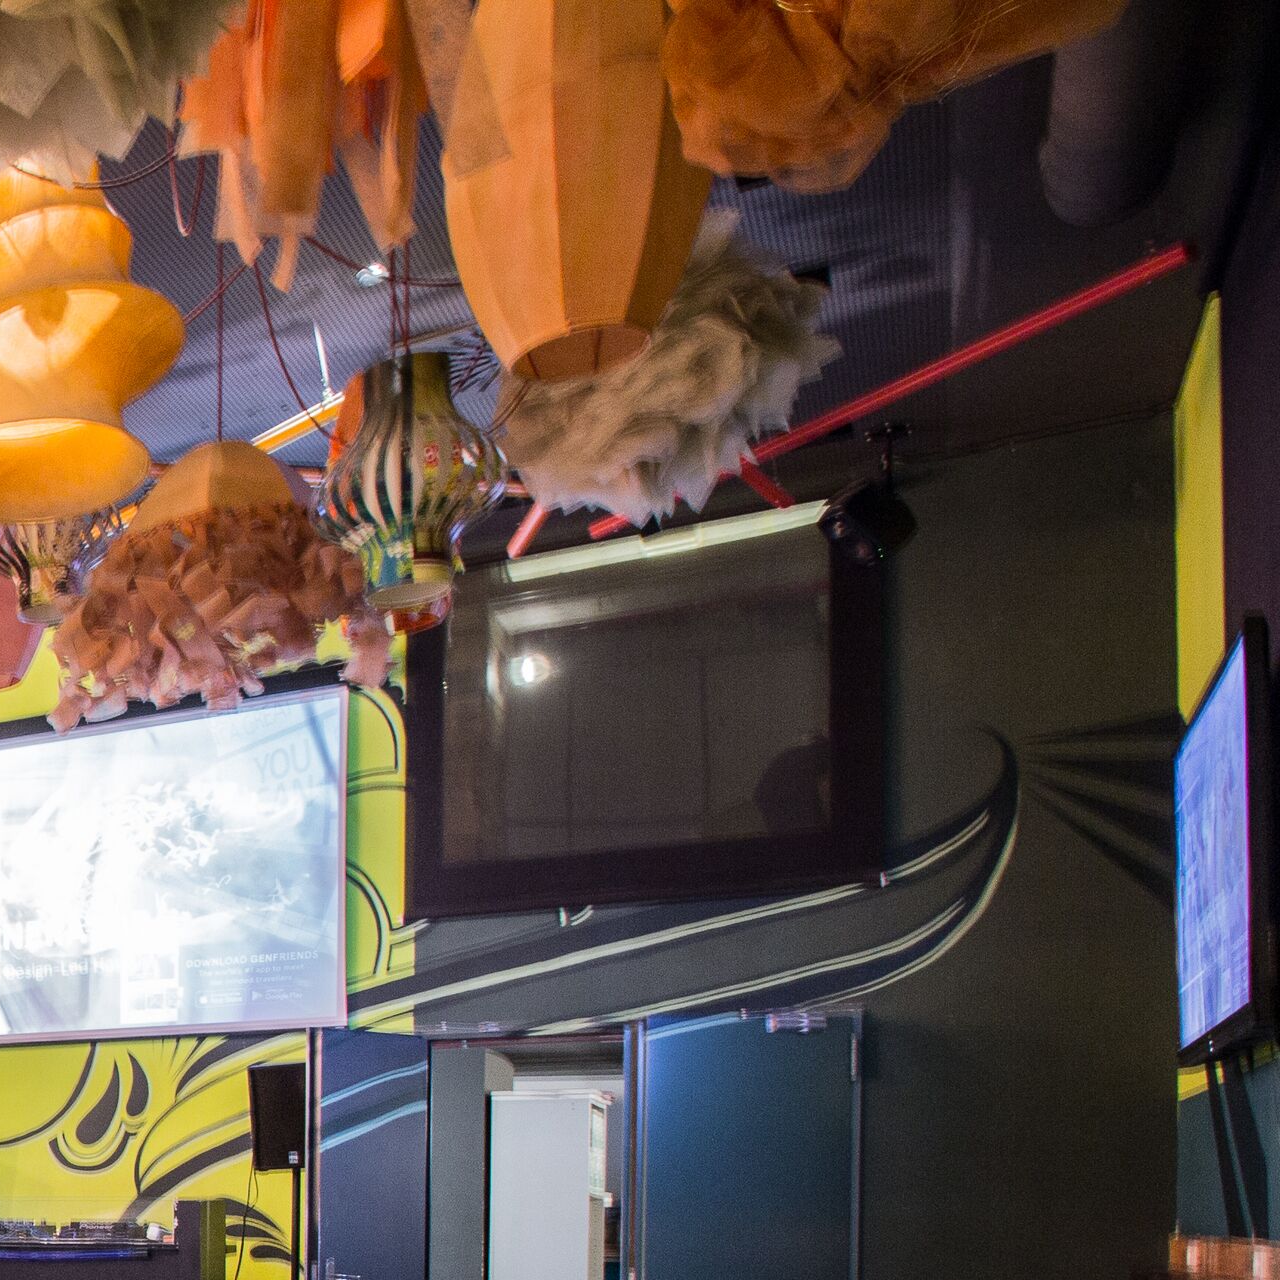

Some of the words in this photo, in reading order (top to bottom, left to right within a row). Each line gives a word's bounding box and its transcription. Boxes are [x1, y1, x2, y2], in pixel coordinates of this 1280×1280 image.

[253, 738, 311, 783] YOU
[185, 955, 247, 969] DOWNLOAD
[249, 950, 320, 964] GENFRIENDS
